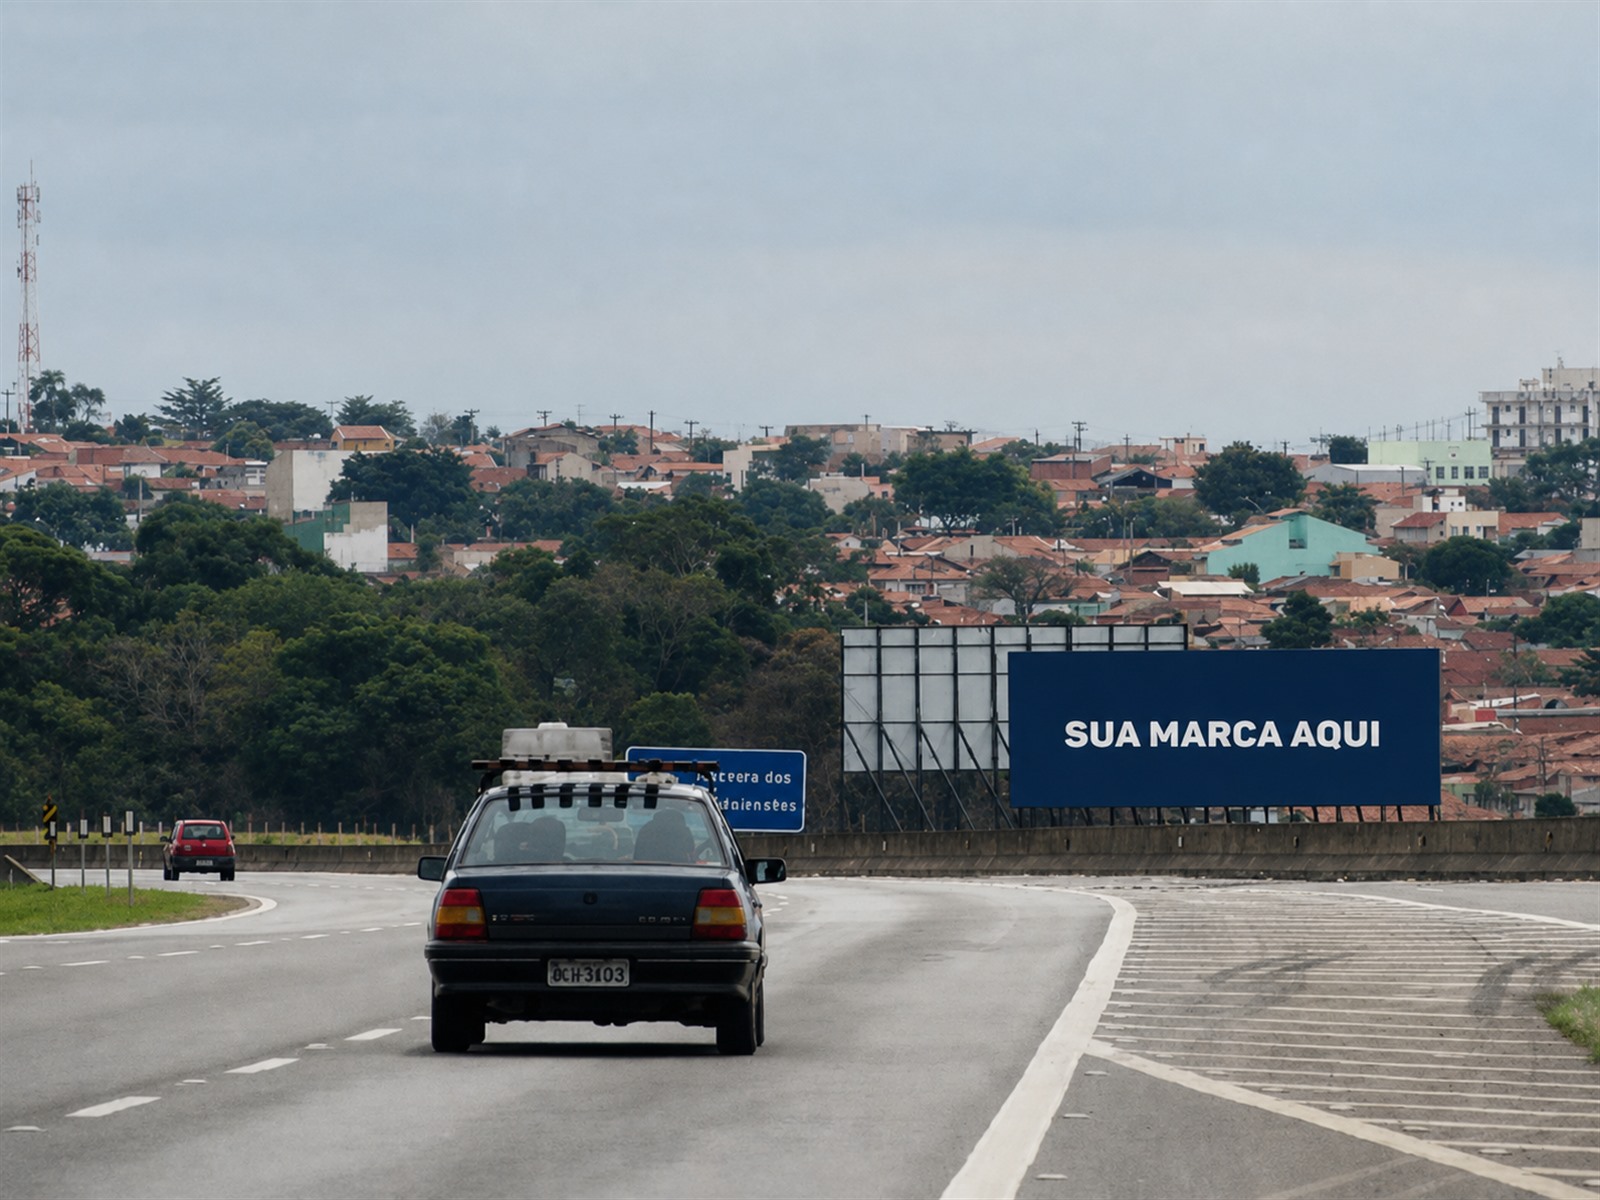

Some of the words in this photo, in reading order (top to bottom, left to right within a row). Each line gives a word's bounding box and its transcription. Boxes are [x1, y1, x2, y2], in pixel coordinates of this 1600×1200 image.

[1064, 720, 1141, 749] SUA
[1150, 720, 1283, 748] MARCA
[1290, 720, 1381, 750] AQUI
[765, 770, 792, 784] dos
